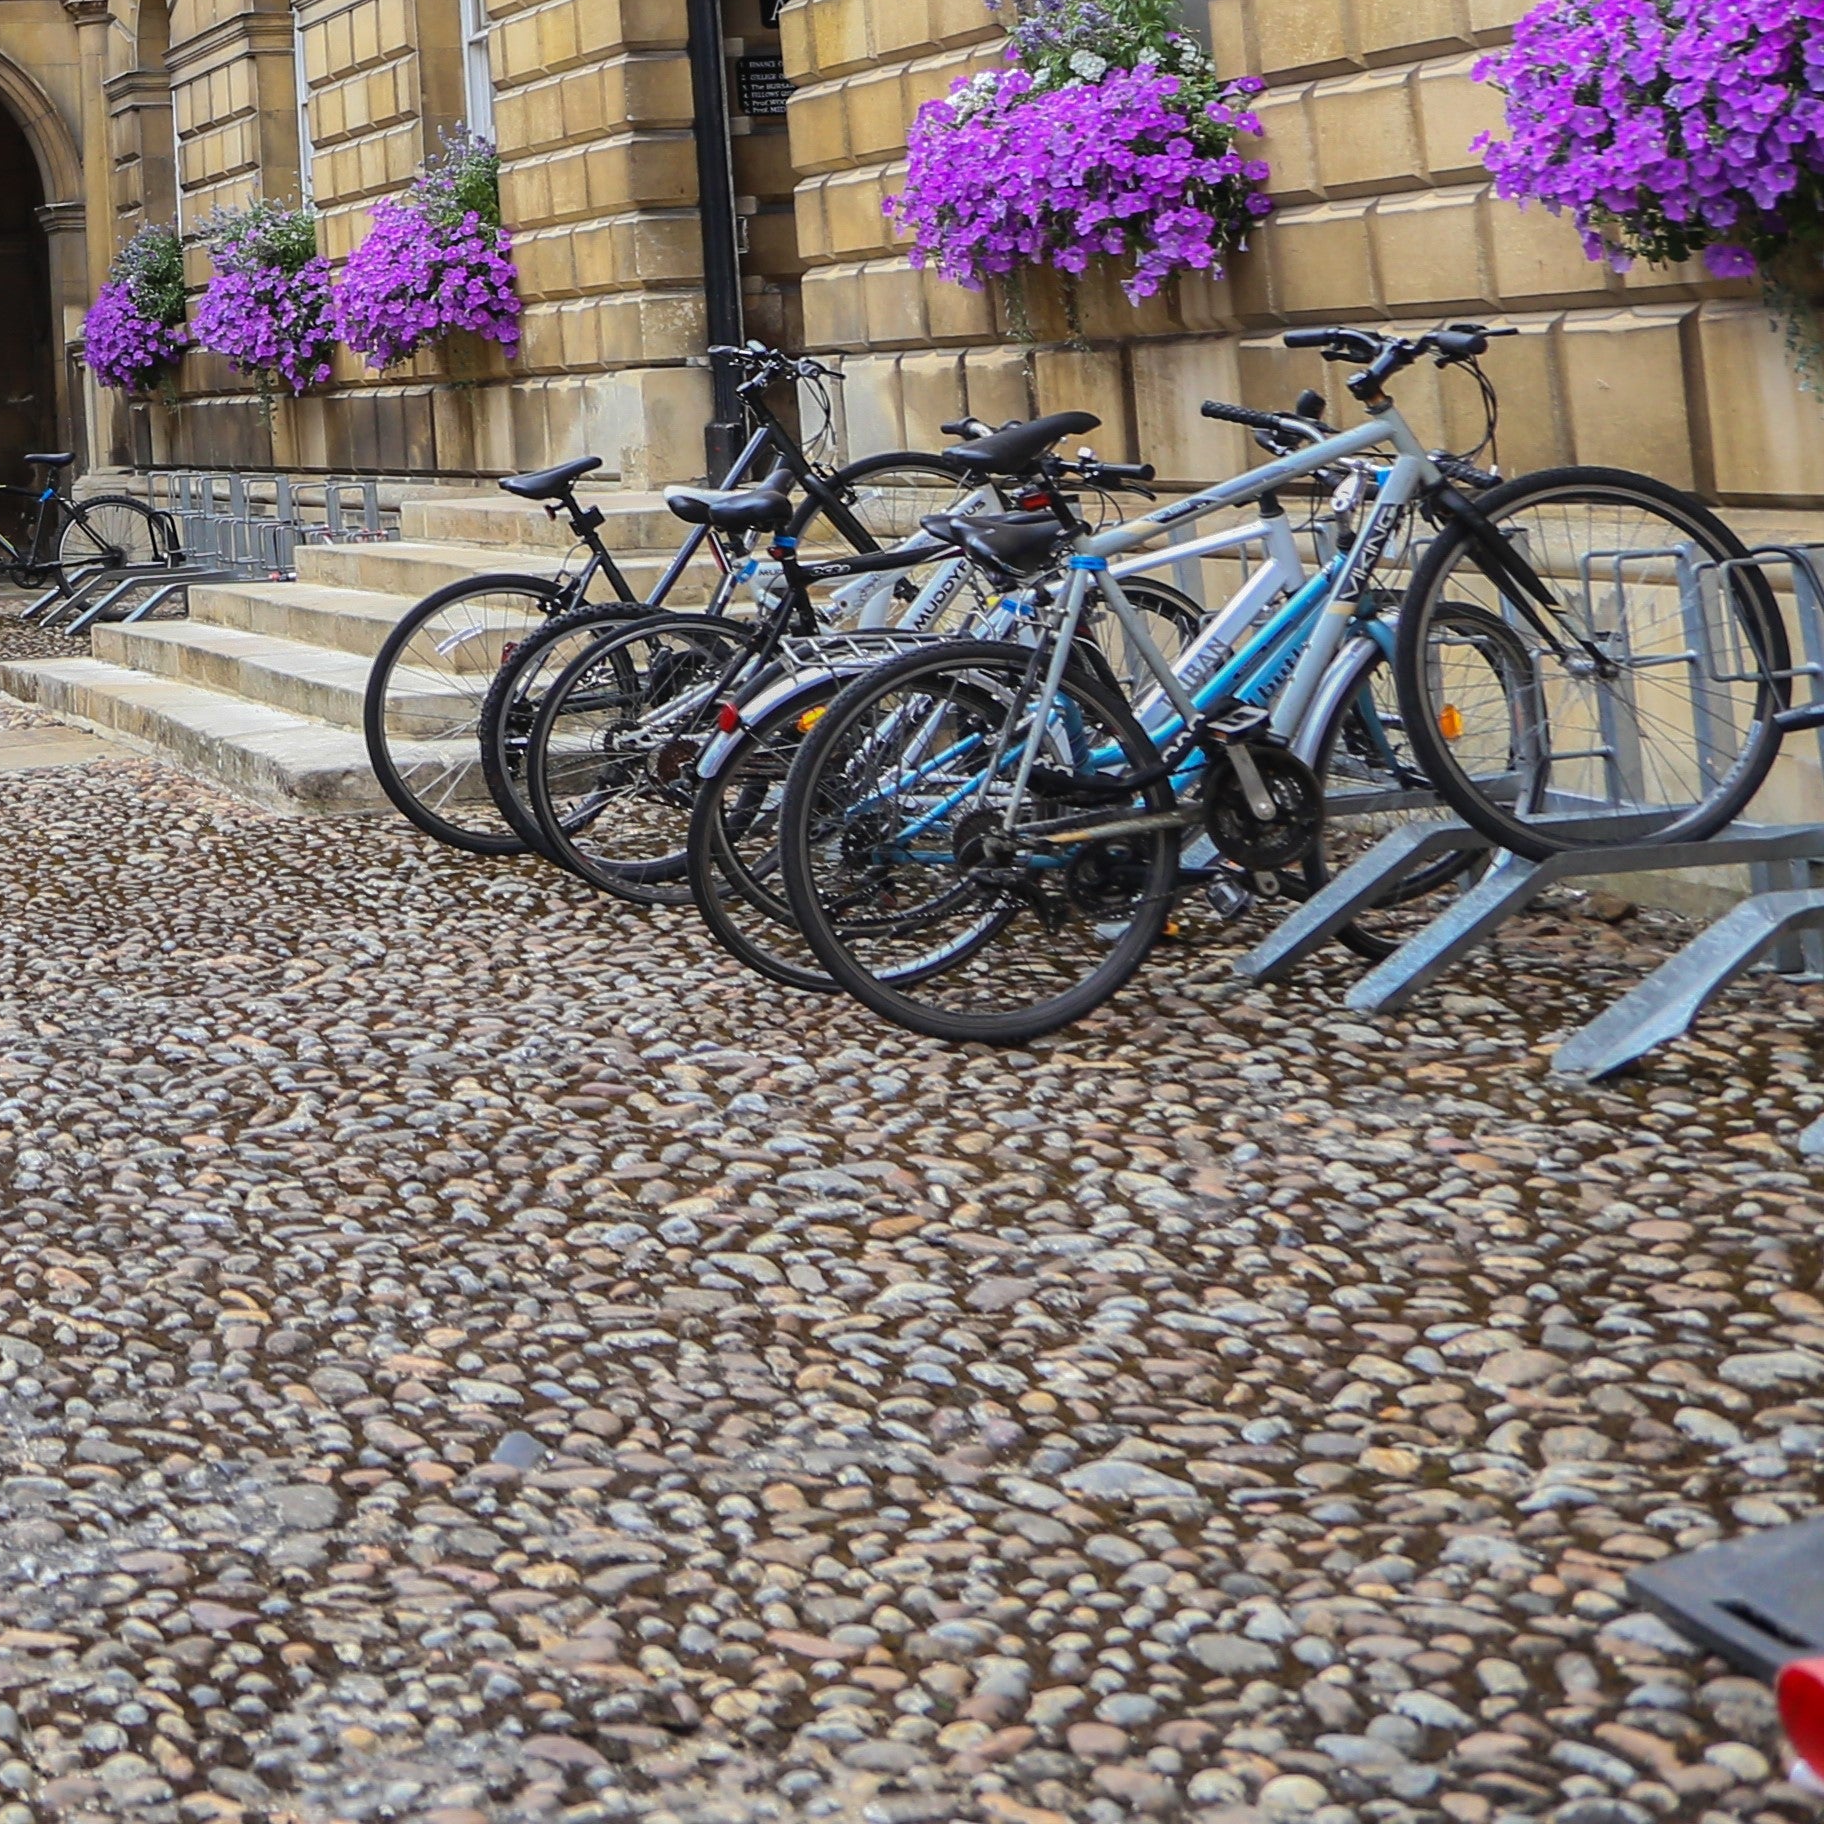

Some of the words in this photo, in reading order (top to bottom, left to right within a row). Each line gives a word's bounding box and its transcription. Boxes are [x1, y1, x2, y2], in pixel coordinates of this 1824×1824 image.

[1339, 506, 1397, 600] VIKING
[913, 559, 969, 631] MUDDYF
[1156, 635, 1228, 706] TIBAN
